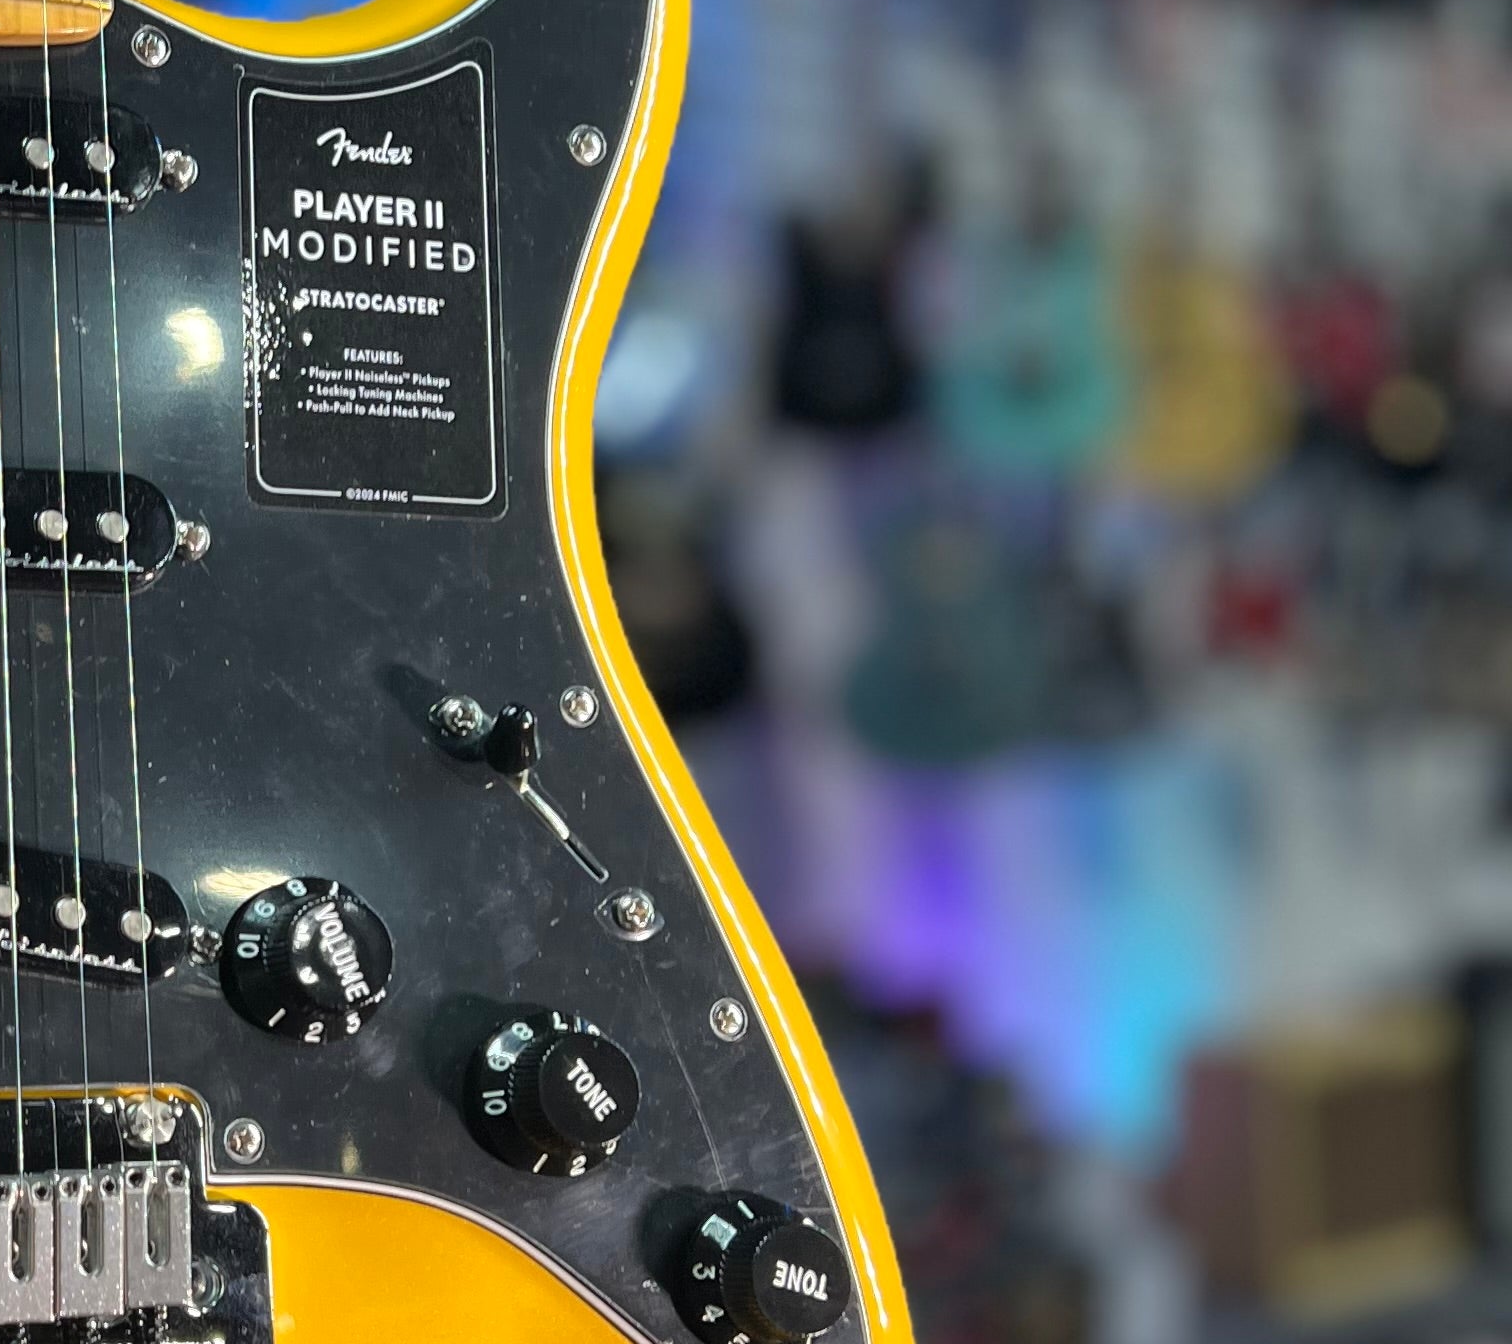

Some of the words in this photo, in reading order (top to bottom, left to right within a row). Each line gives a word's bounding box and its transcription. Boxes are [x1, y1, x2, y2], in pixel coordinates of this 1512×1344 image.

[293, 188, 418, 228] PLAYER
[424, 199, 444, 230] II
[262, 226, 476, 273] MODIFIED
[344, 347, 404, 366] FEATURES:
[309, 366, 342, 382] Player
[344, 368, 353, 381] II
[412, 373, 451, 390] Pickups
[317, 383, 357, 400] Locking
[359, 386, 392, 403] Tuning
[395, 389, 444, 404] Machines
[306, 399, 352, 415] Push-Pull
[355, 402, 365, 416] to
[368, 403, 389, 417] Add
[393, 404, 419, 419] Neck
[422, 407, 456, 423] Pickup
[382, 489, 409, 503] FMIC
[237, 933, 261, 959] 10
[315, 902, 370, 1002] VOLUME
[304, 1021, 324, 1043] 2
[566, 1057, 617, 1122] TONE
[482, 1090, 508, 1116] 10
[569, 1155, 587, 1177] 2
[692, 1262, 716, 1280] 3
[772, 1259, 828, 1301] TONE
[702, 1304, 724, 1323] 4
